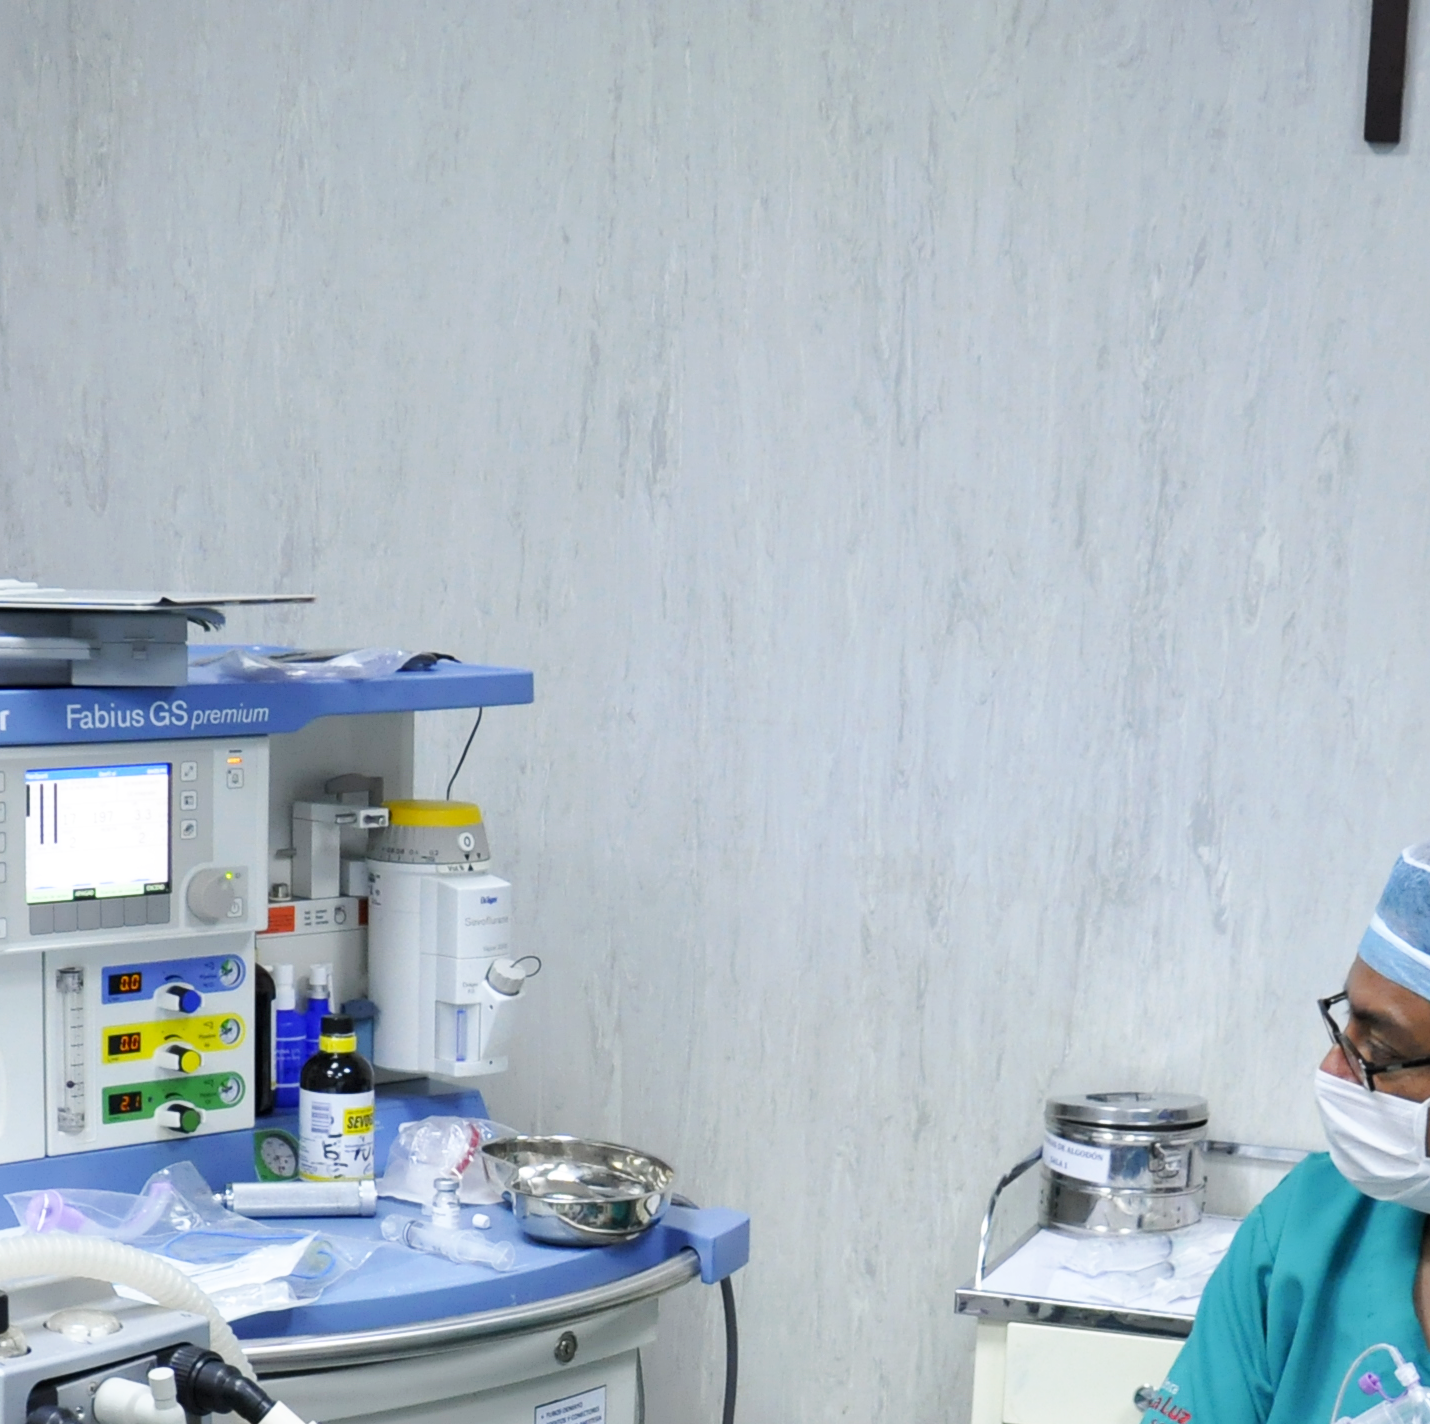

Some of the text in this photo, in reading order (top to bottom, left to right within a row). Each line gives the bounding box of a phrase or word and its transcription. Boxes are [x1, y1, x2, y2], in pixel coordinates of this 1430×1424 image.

[66, 700, 270, 730] Fabius GS premium
